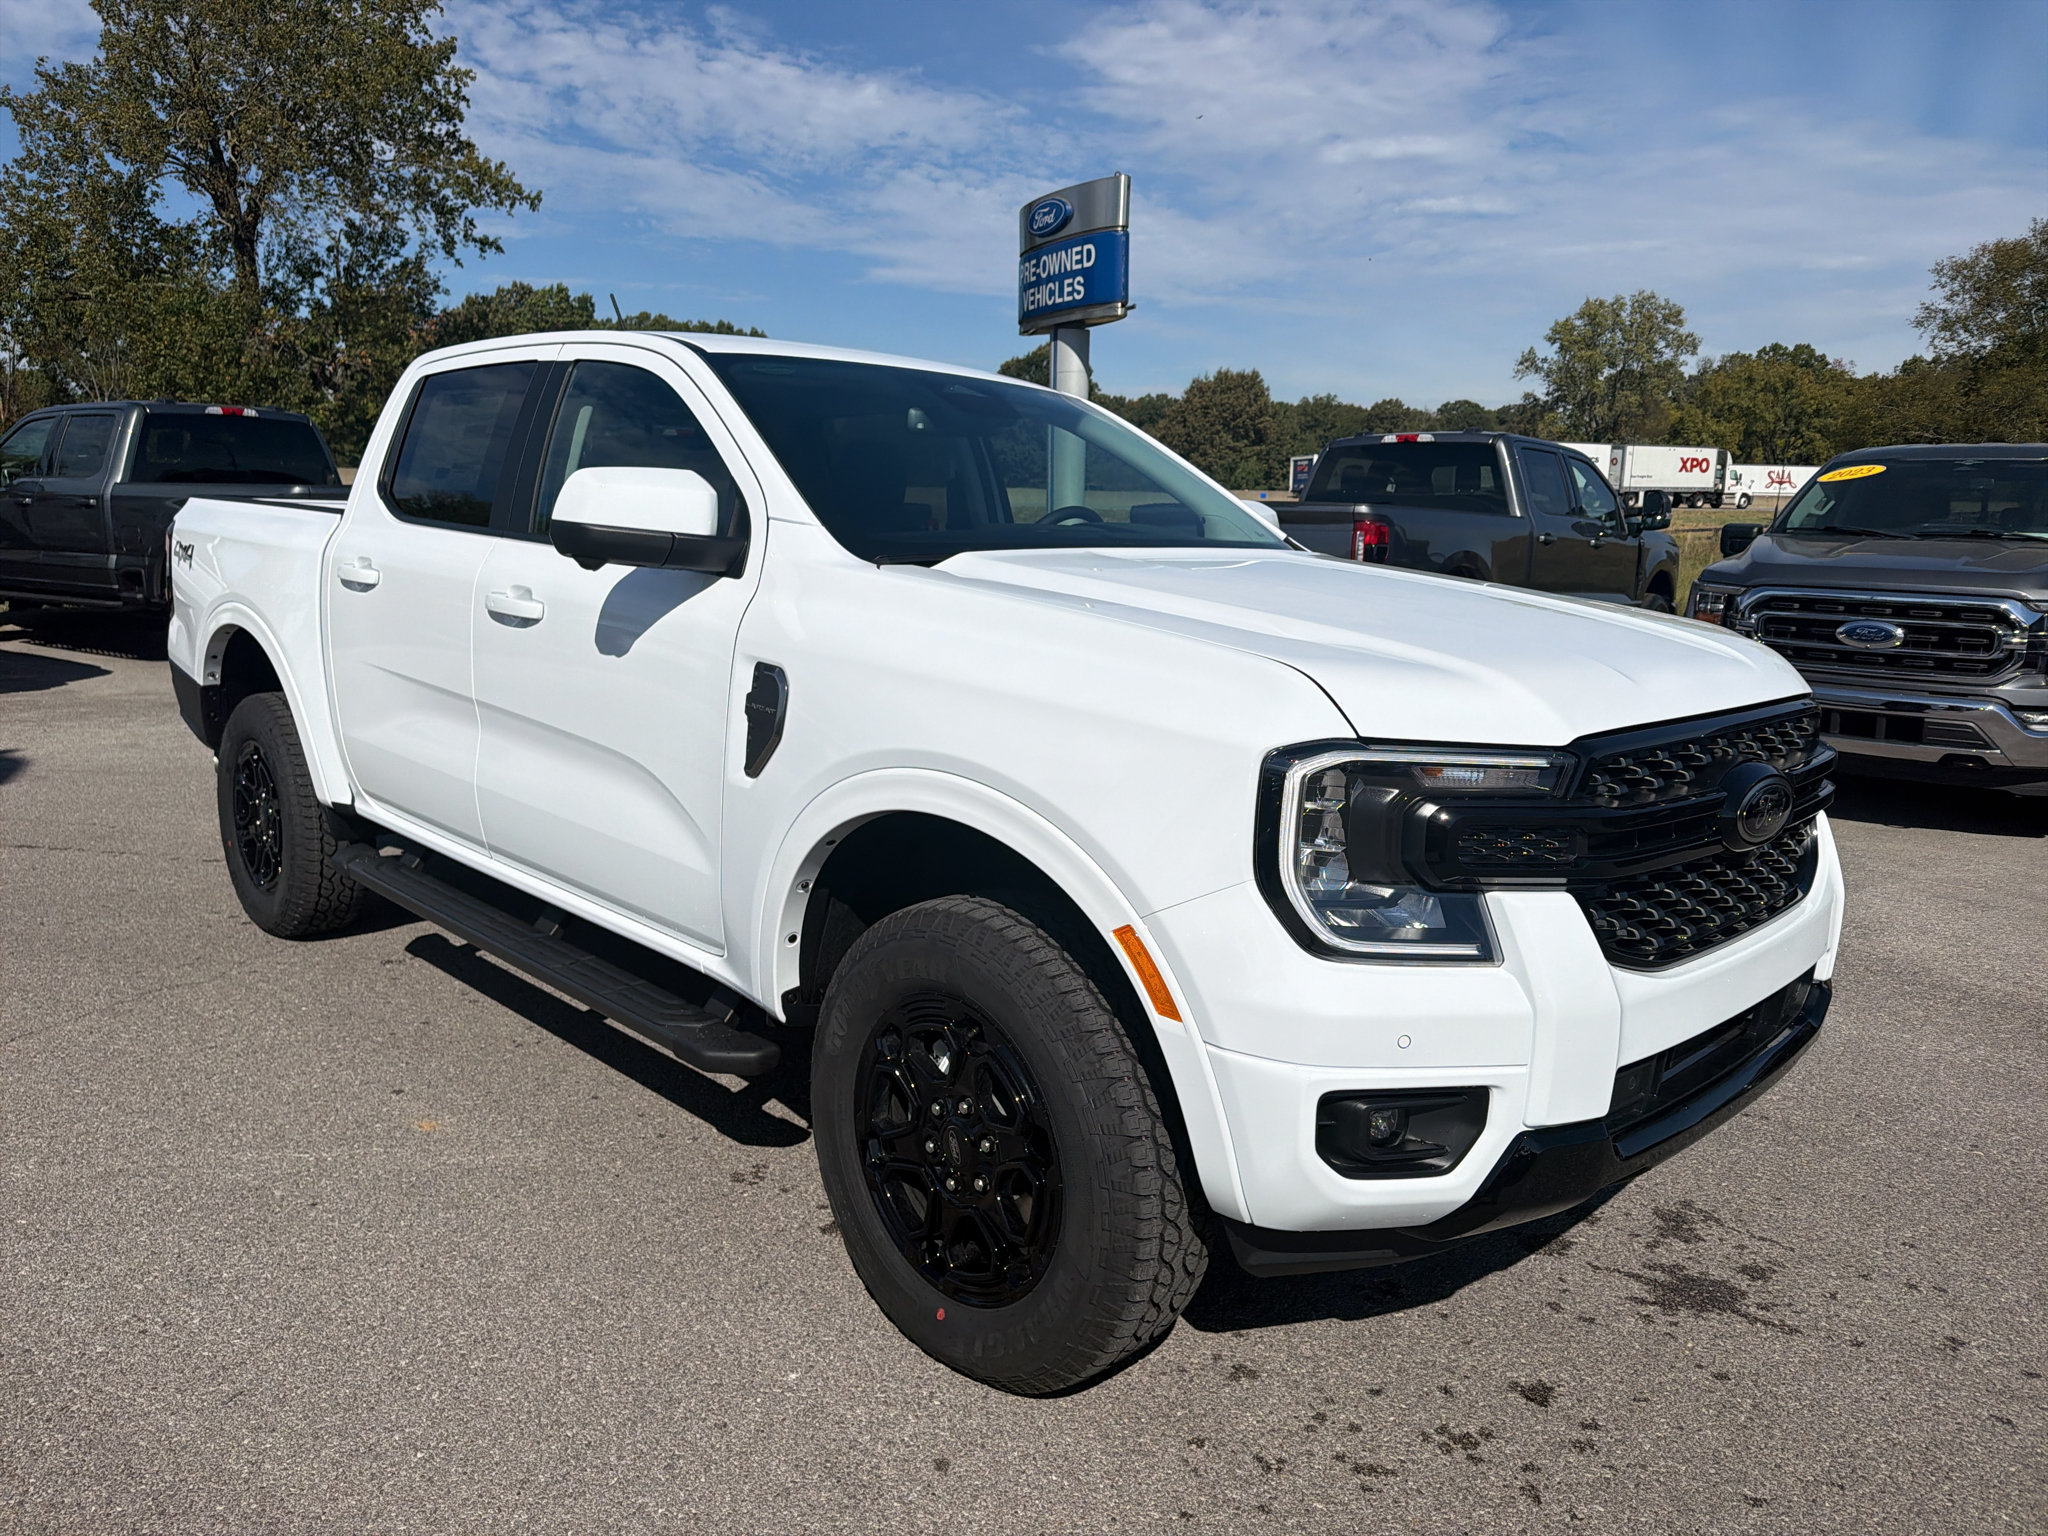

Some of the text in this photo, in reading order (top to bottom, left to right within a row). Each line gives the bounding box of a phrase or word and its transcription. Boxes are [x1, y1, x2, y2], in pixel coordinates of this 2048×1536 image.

[1033, 207, 1056, 230] Ford
[1023, 275, 1085, 313] VEHICLES
[1678, 457, 1710, 474] XPO
[1829, 466, 1876, 481] 2023
[1853, 627, 1885, 641] Ford
